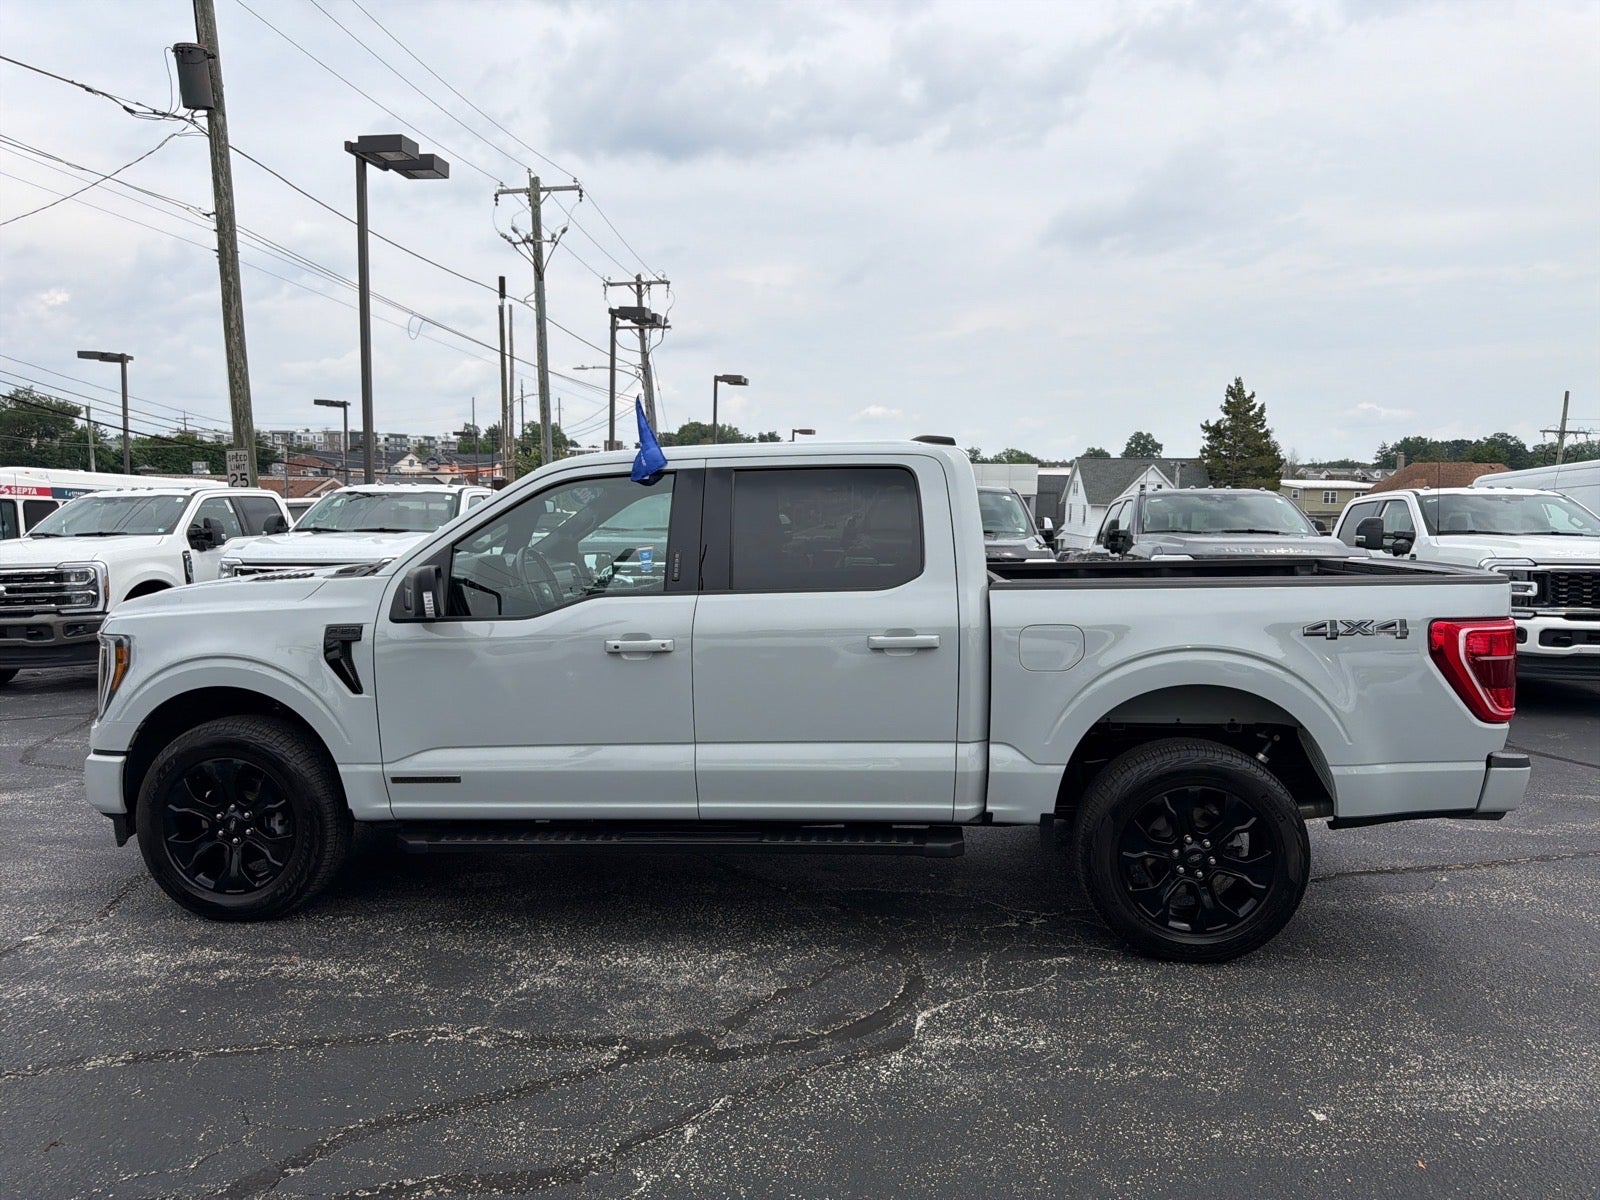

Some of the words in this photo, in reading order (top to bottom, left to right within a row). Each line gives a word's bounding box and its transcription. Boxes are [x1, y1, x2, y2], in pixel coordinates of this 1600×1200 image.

[228, 454, 247, 462] SPEED
[230, 463, 246, 471] LIMIT
[230, 473, 249, 487] 25
[11, 487, 37, 495] SEPTA
[1303, 619, 1409, 640] 4X4
